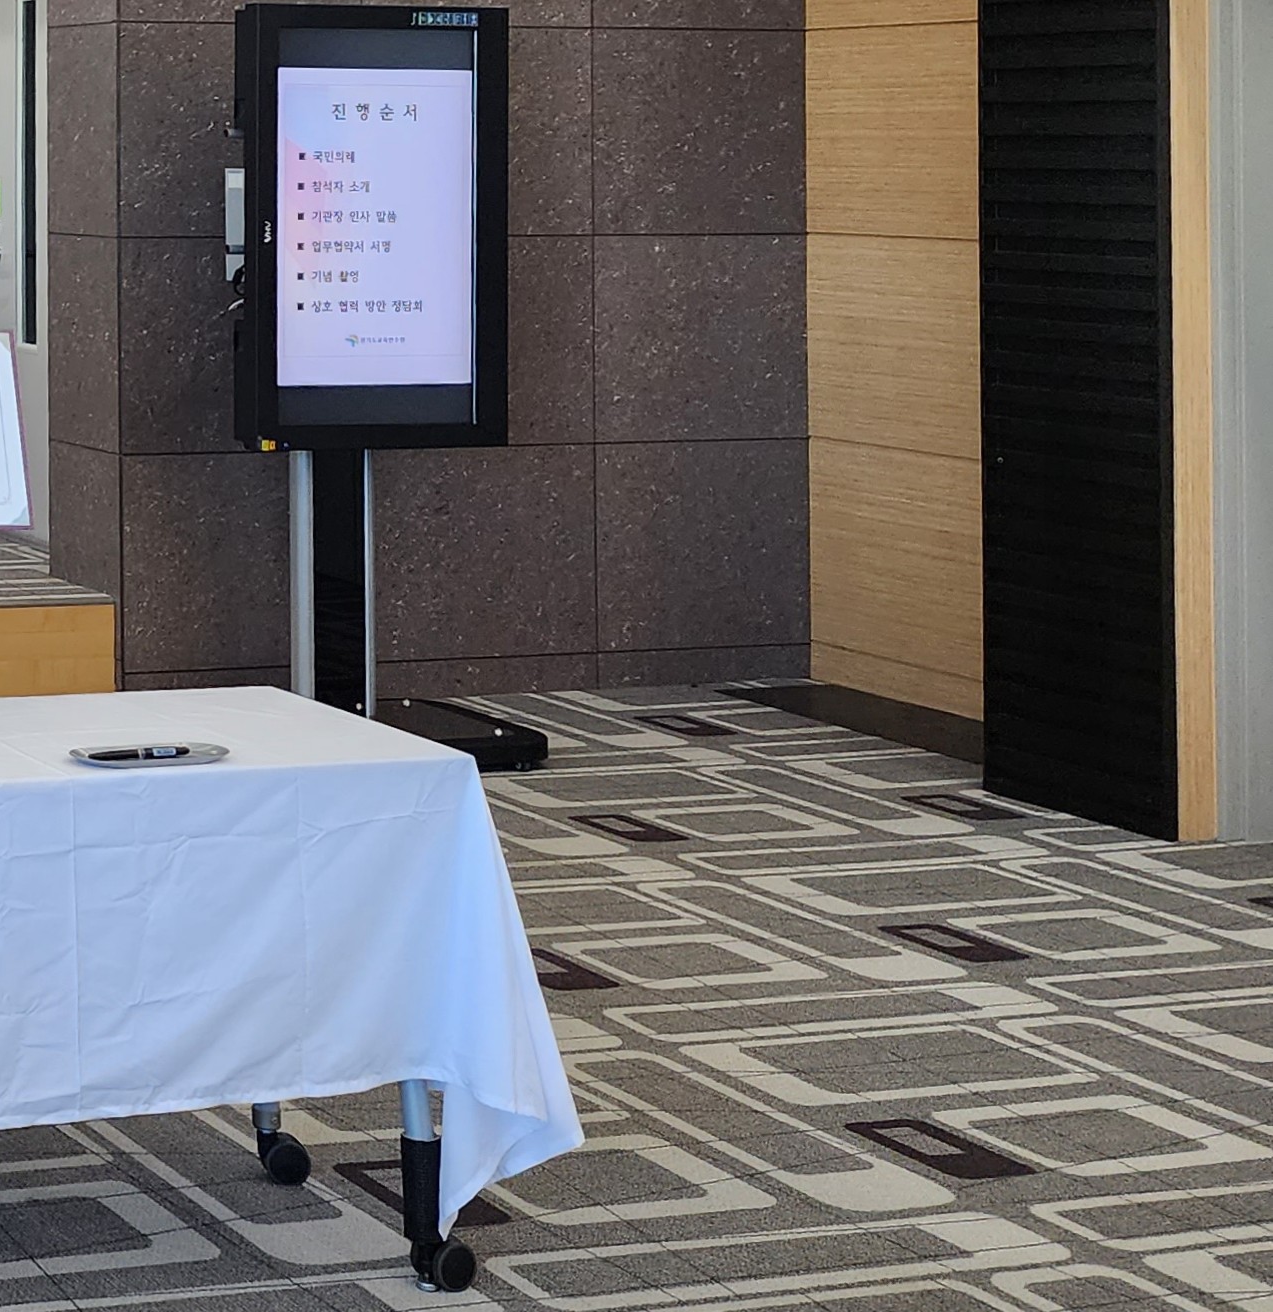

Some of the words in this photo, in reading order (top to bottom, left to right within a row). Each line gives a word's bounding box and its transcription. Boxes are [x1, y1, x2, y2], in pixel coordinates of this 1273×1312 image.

[312, 151, 356, 163] 국민의례
[311, 180, 344, 194] 참석자
[349, 180, 370, 193] 소개
[311, 210, 344, 224] 기관장
[349, 210, 370, 223] 인사
[311, 240, 365, 254] 업무협약서
[370, 240, 392, 254] 서명
[311, 270, 333, 284] 기념
[311, 300, 334, 314] 상호
[365, 300, 387, 313] 방안
[391, 300, 424, 313] 정담회
